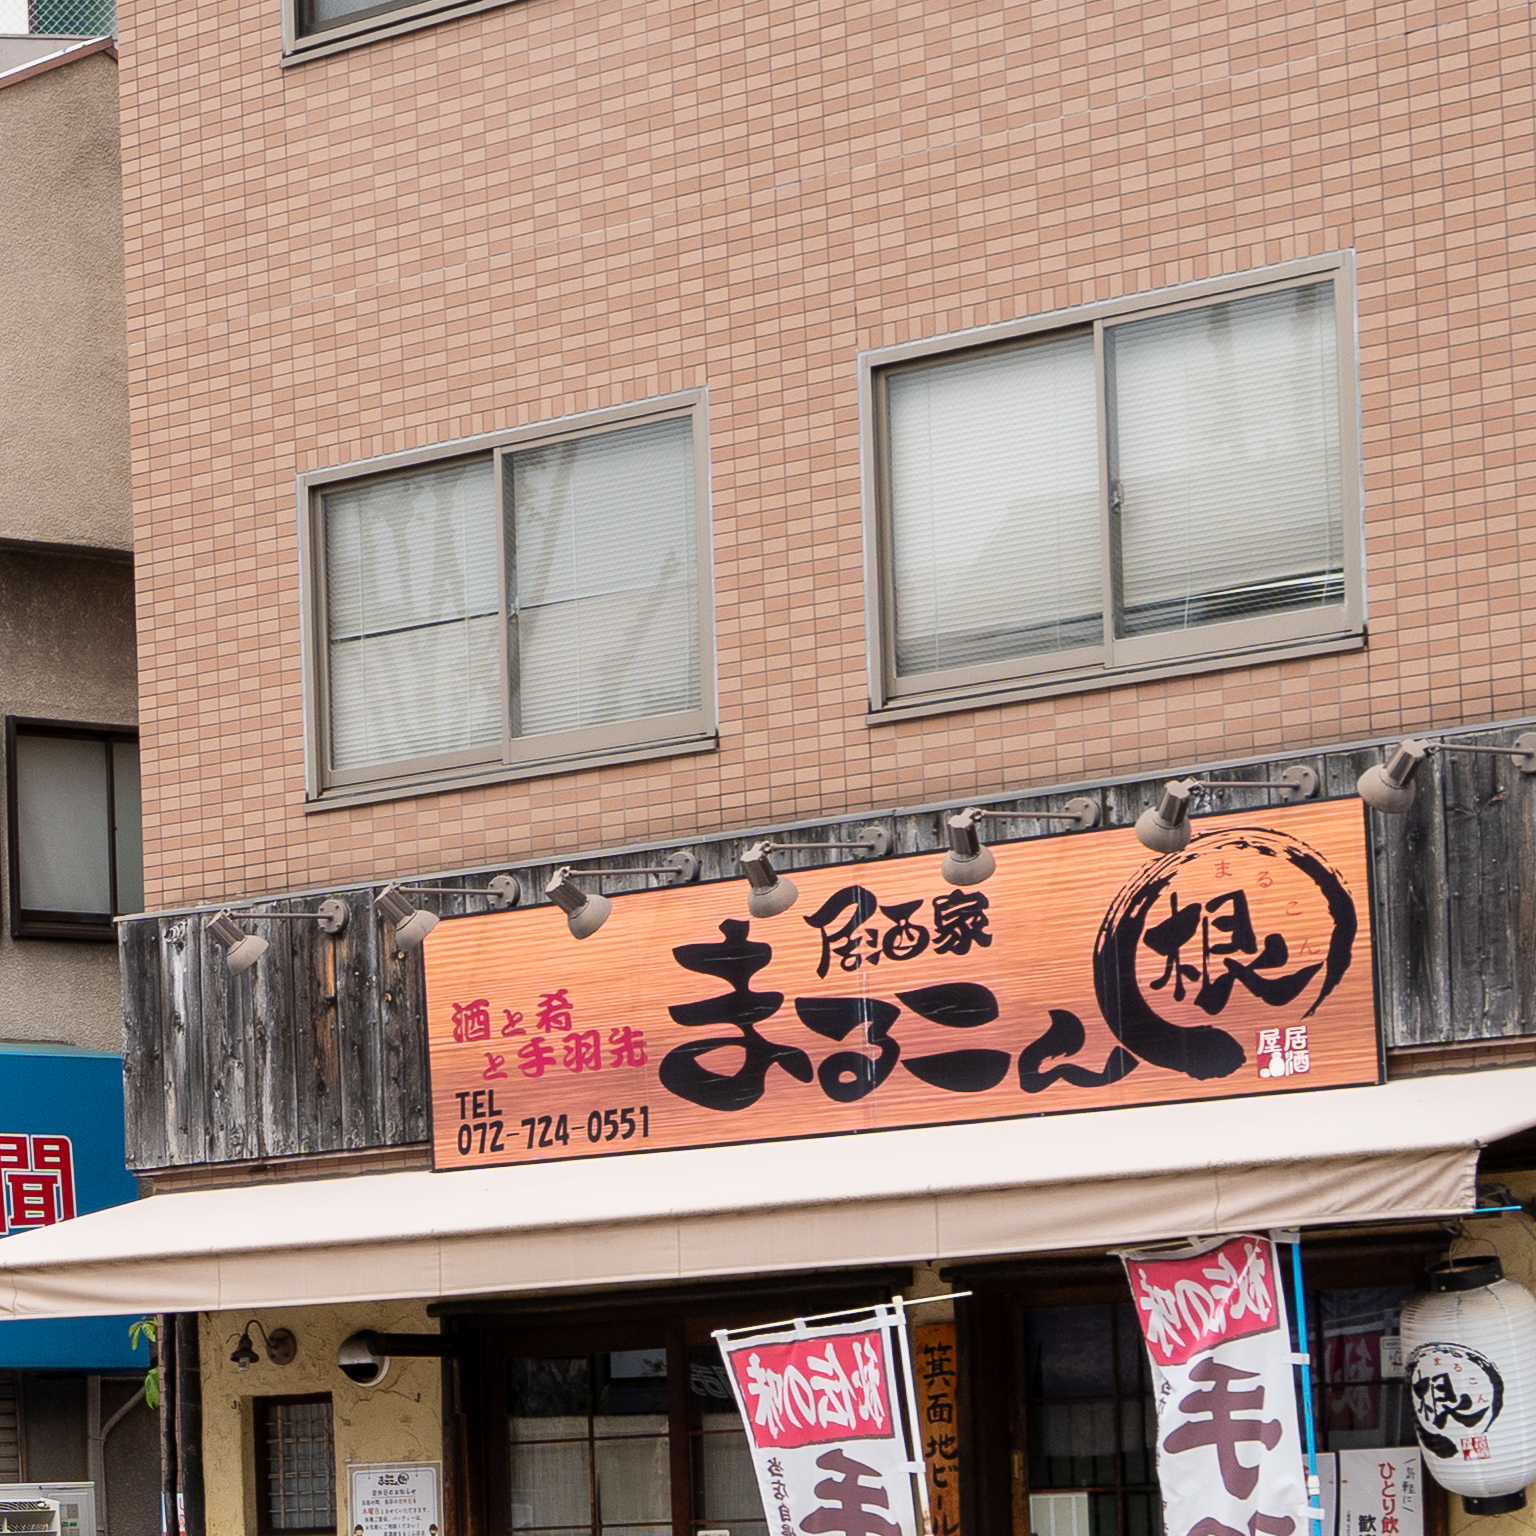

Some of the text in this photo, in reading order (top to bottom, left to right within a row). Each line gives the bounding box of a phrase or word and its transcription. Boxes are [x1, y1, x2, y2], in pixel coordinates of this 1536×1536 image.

[1142, 889, 1325, 1016] 根
[451, 988, 574, 1044] 酒と肴
[482, 1026, 649, 1080] と手羽先
[455, 1089, 503, 1120] TEL
[457, 1105, 650, 1156] 072-724-0551
[923, 1341, 959, 1536] 箕面地ビール
